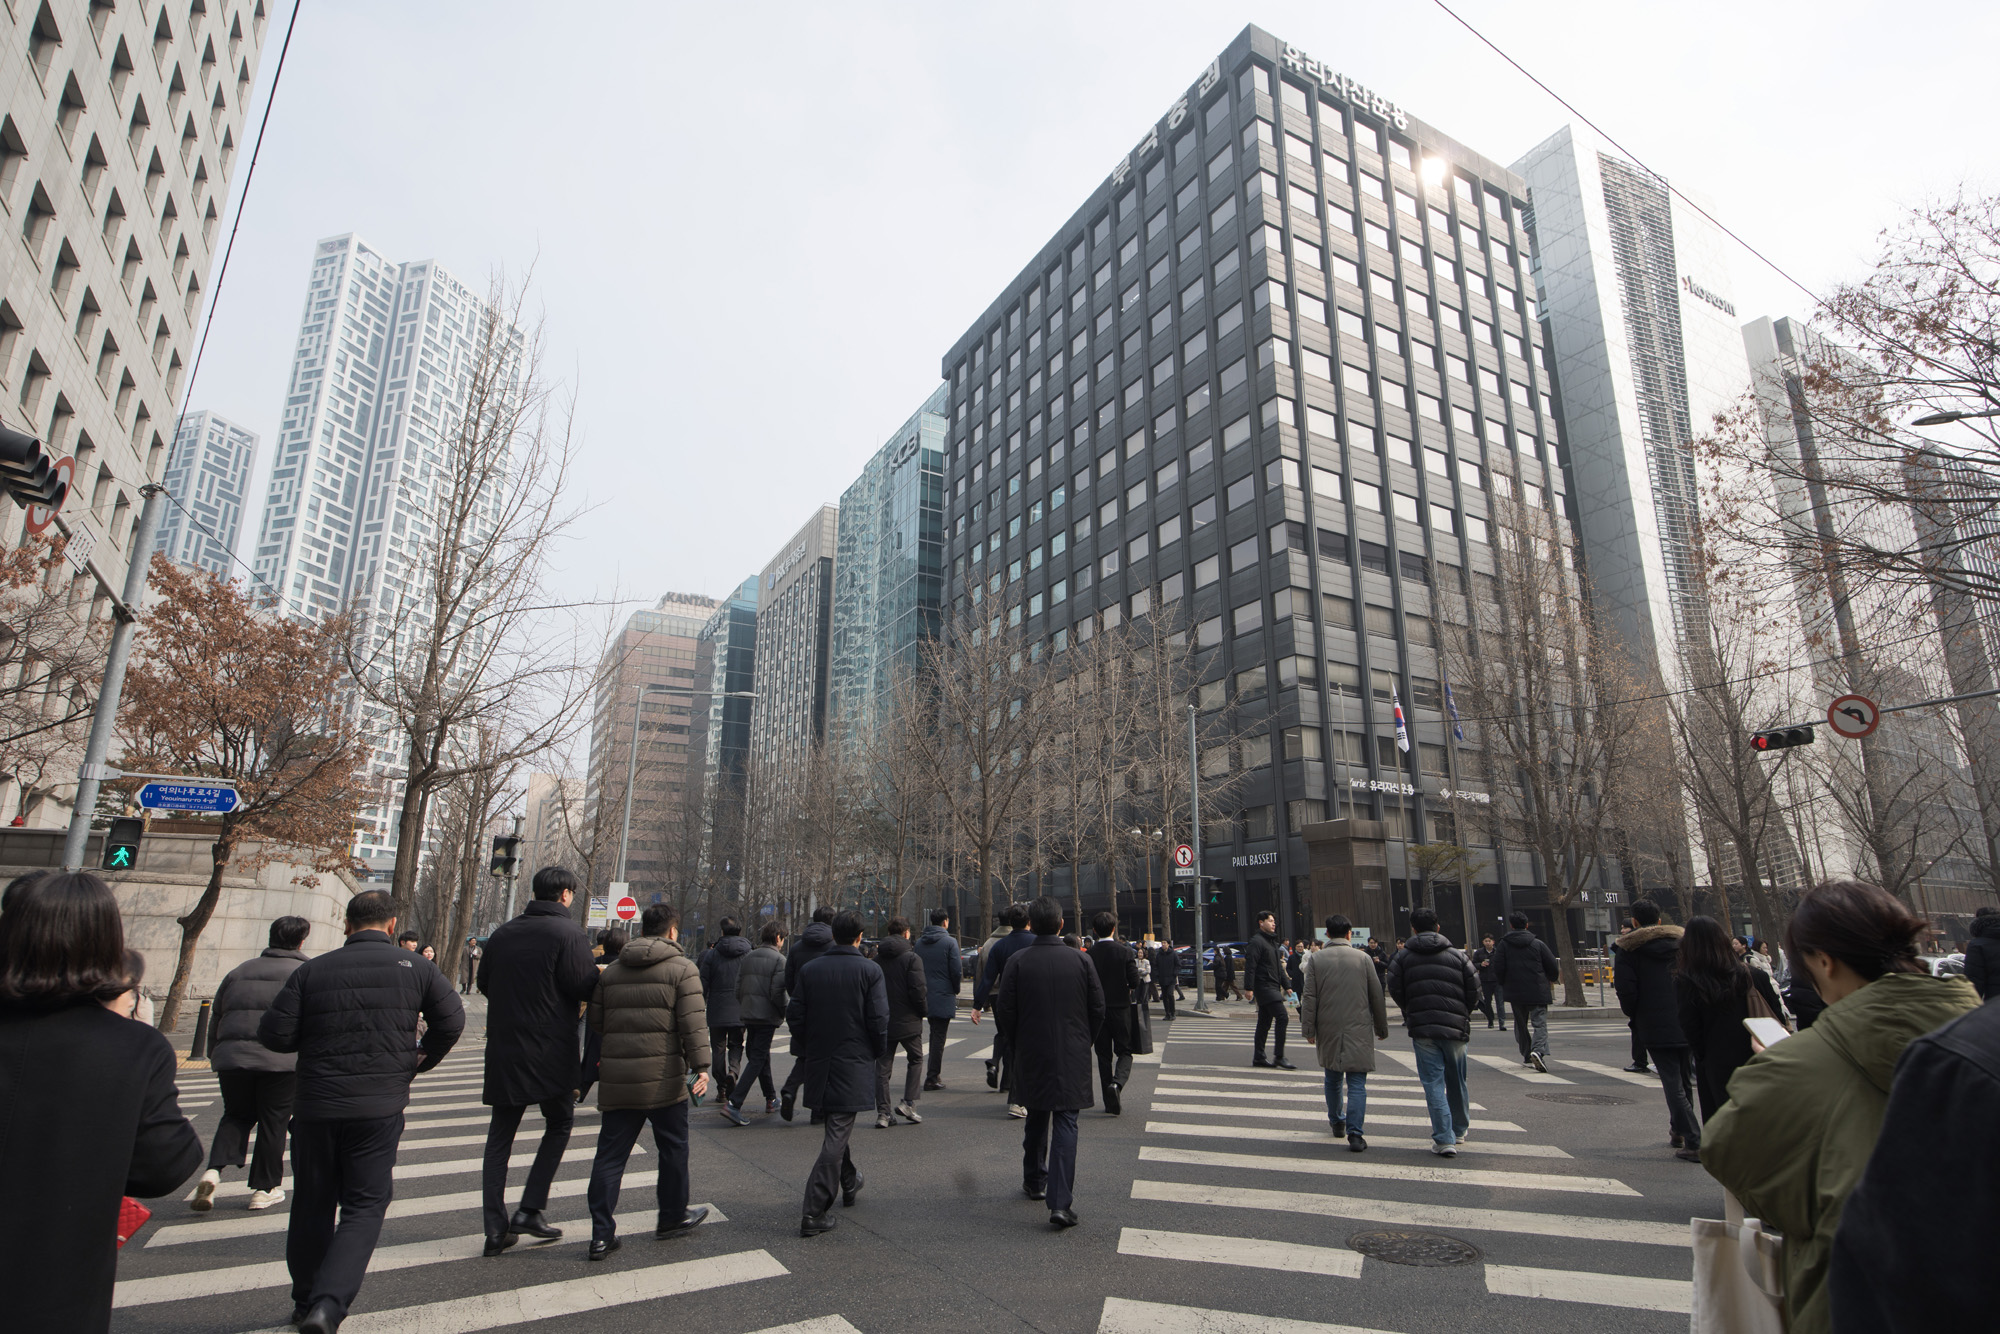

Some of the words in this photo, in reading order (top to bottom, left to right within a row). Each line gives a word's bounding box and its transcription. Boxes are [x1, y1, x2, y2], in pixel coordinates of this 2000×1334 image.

[1281, 42, 1409, 131] 유리자산운용
[1112, 55, 1221, 187] 부국증권
[1686, 275, 1737, 317] koscom
[890, 431, 920, 475] KCB
[665, 591, 716, 609] KANTAR
[158, 786, 221, 798] 여의나루로4길
[160, 795, 202, 804] Yeouinaru-ro
[1232, 856, 1249, 868] PAUL
[1249, 852, 1278, 866] BASSETT
